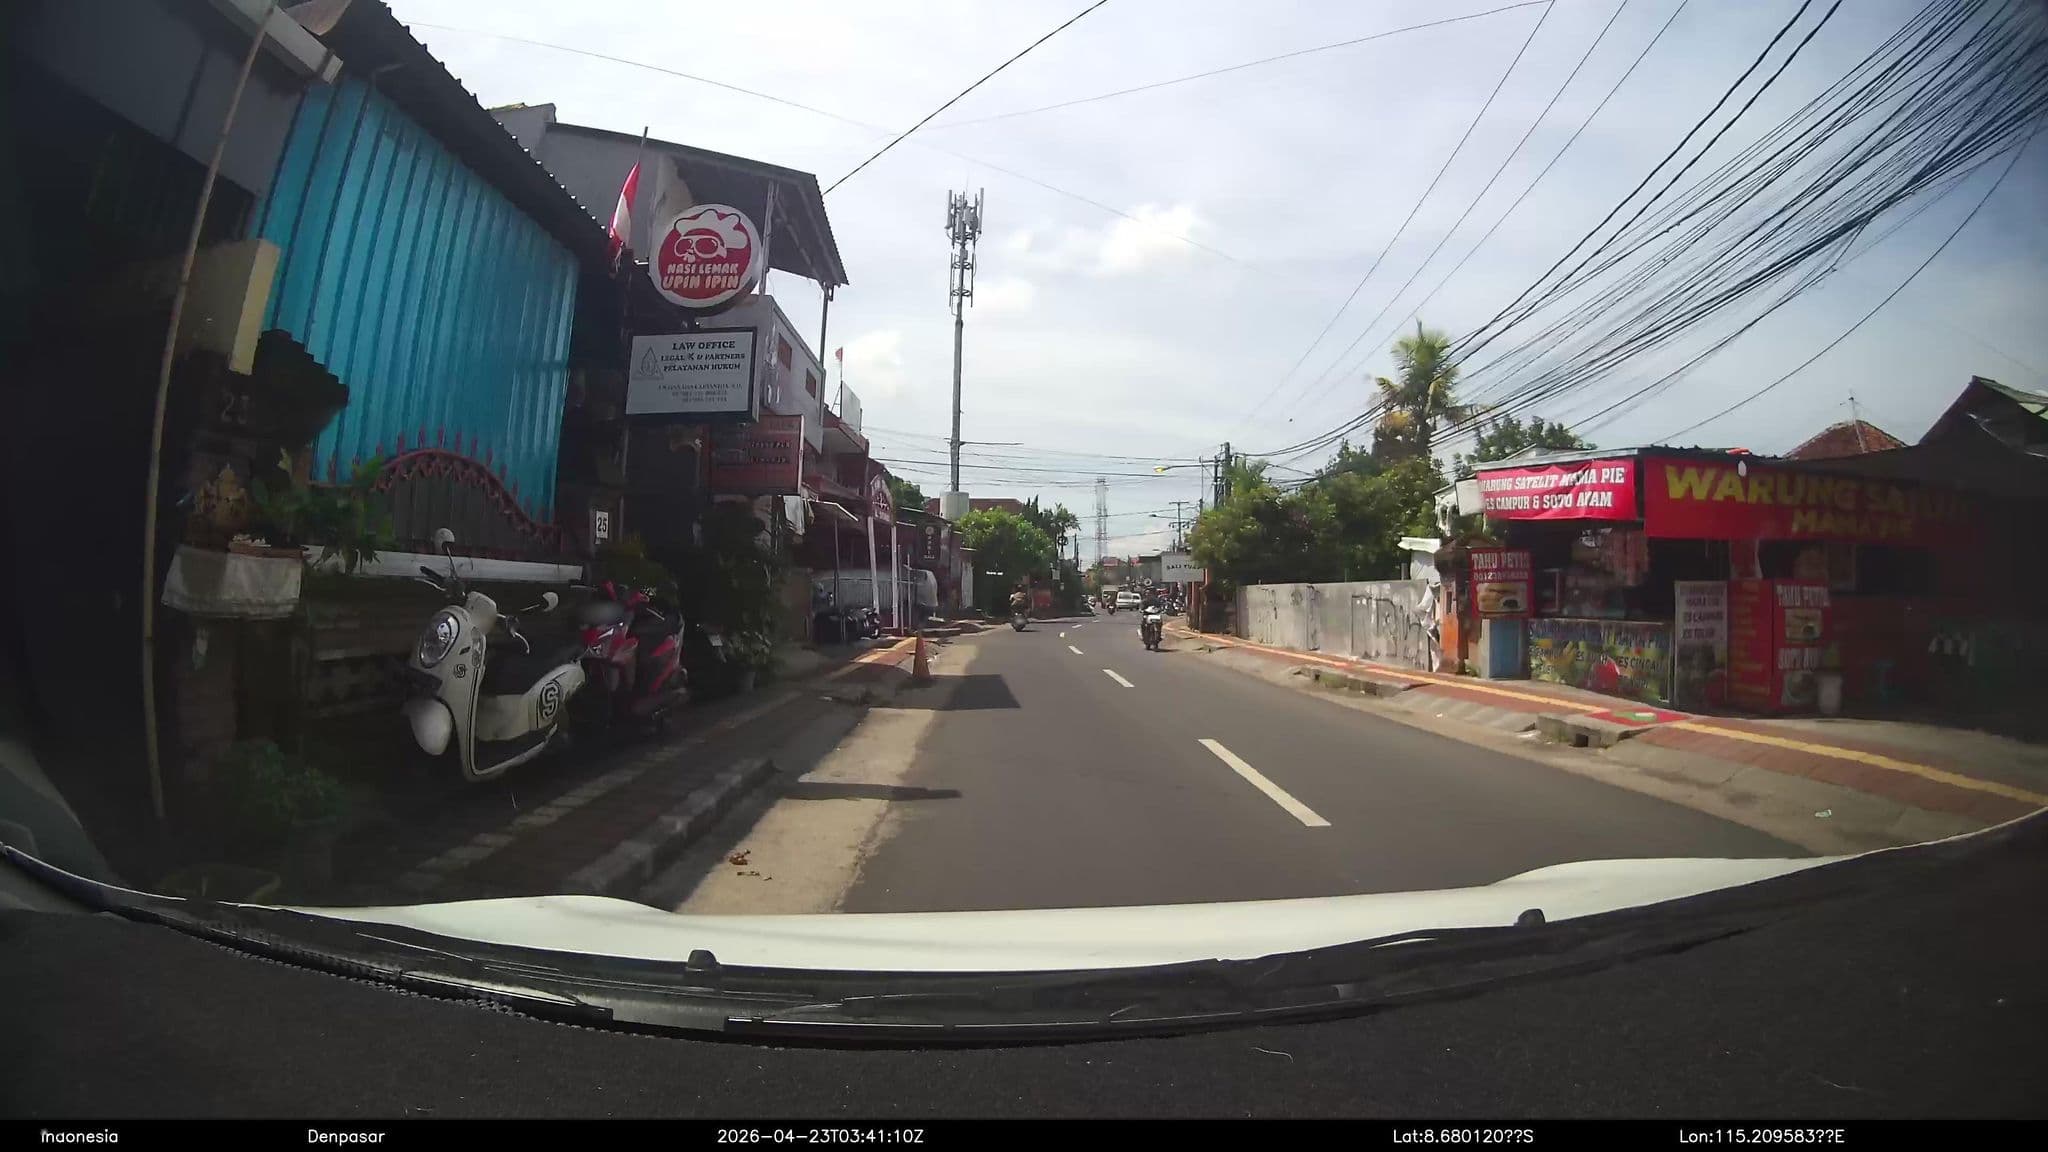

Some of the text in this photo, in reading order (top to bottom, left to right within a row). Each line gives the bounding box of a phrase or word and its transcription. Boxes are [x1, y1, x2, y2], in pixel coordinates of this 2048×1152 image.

[667, 263, 738, 274] NASI LEMAK
[663, 274, 740, 290] UPIN IPIN
[672, 341, 736, 350] LAW OFFICE
[705, 353, 745, 361] PARTNERS
[663, 363, 741, 372] PELAYANAN HUKUM
[1514, 474, 1559, 490] SATELIT
[1600, 467, 1625, 484] PIE
[1664, 464, 1857, 510] WARUNG
[1486, 498, 1495, 510] ES
[1496, 496, 1530, 510] CAMPUR
[1543, 493, 1573, 509] SOTO
[1577, 491, 1613, 507] AYAM
[598, 517, 608, 532] 25
[1472, 552, 1498, 569] TAHU
